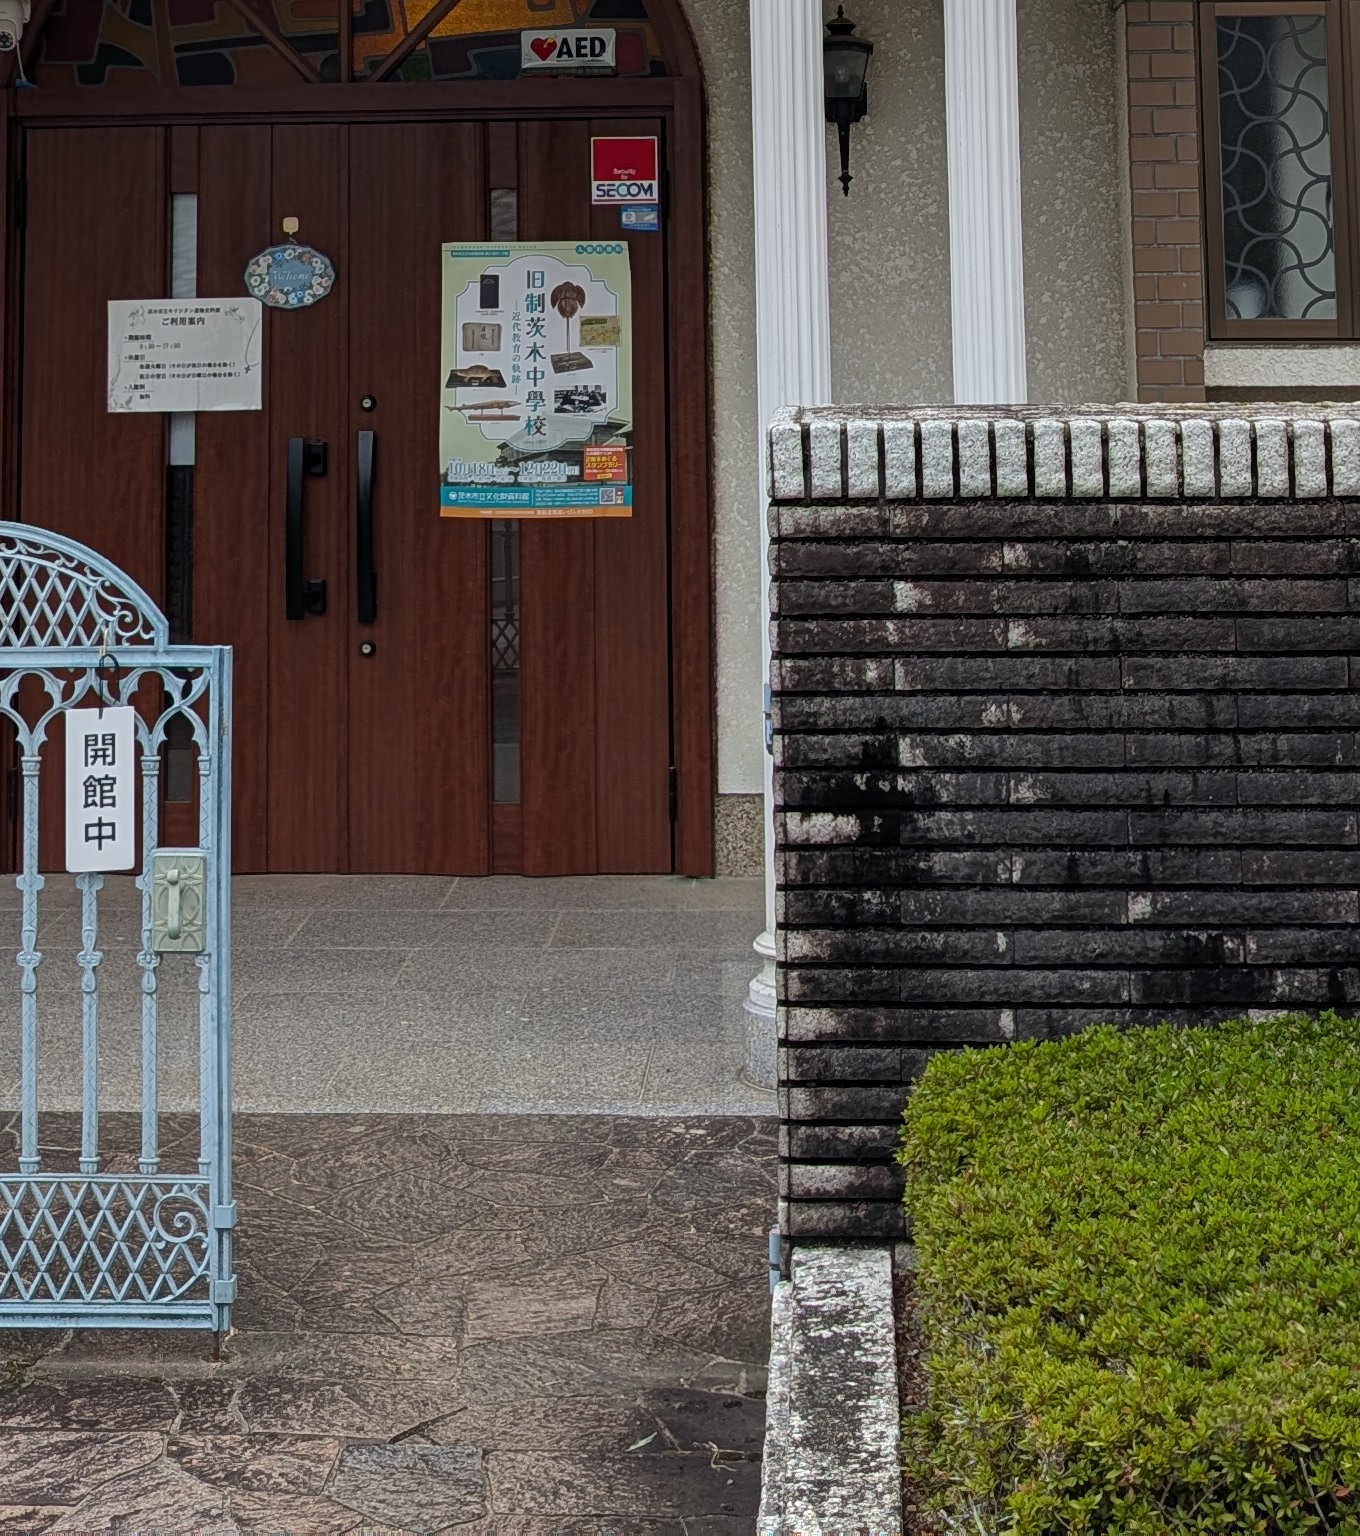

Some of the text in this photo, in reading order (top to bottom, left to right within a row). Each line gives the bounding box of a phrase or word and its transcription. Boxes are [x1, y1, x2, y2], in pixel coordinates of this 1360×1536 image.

[556, 36, 607, 59] AED
[595, 182, 654, 198] SECOM
[161, 316, 206, 326] ご利用案内
[524, 270, 547, 437] 旧制茨木中學校
[82, 732, 117, 852] 開館中
